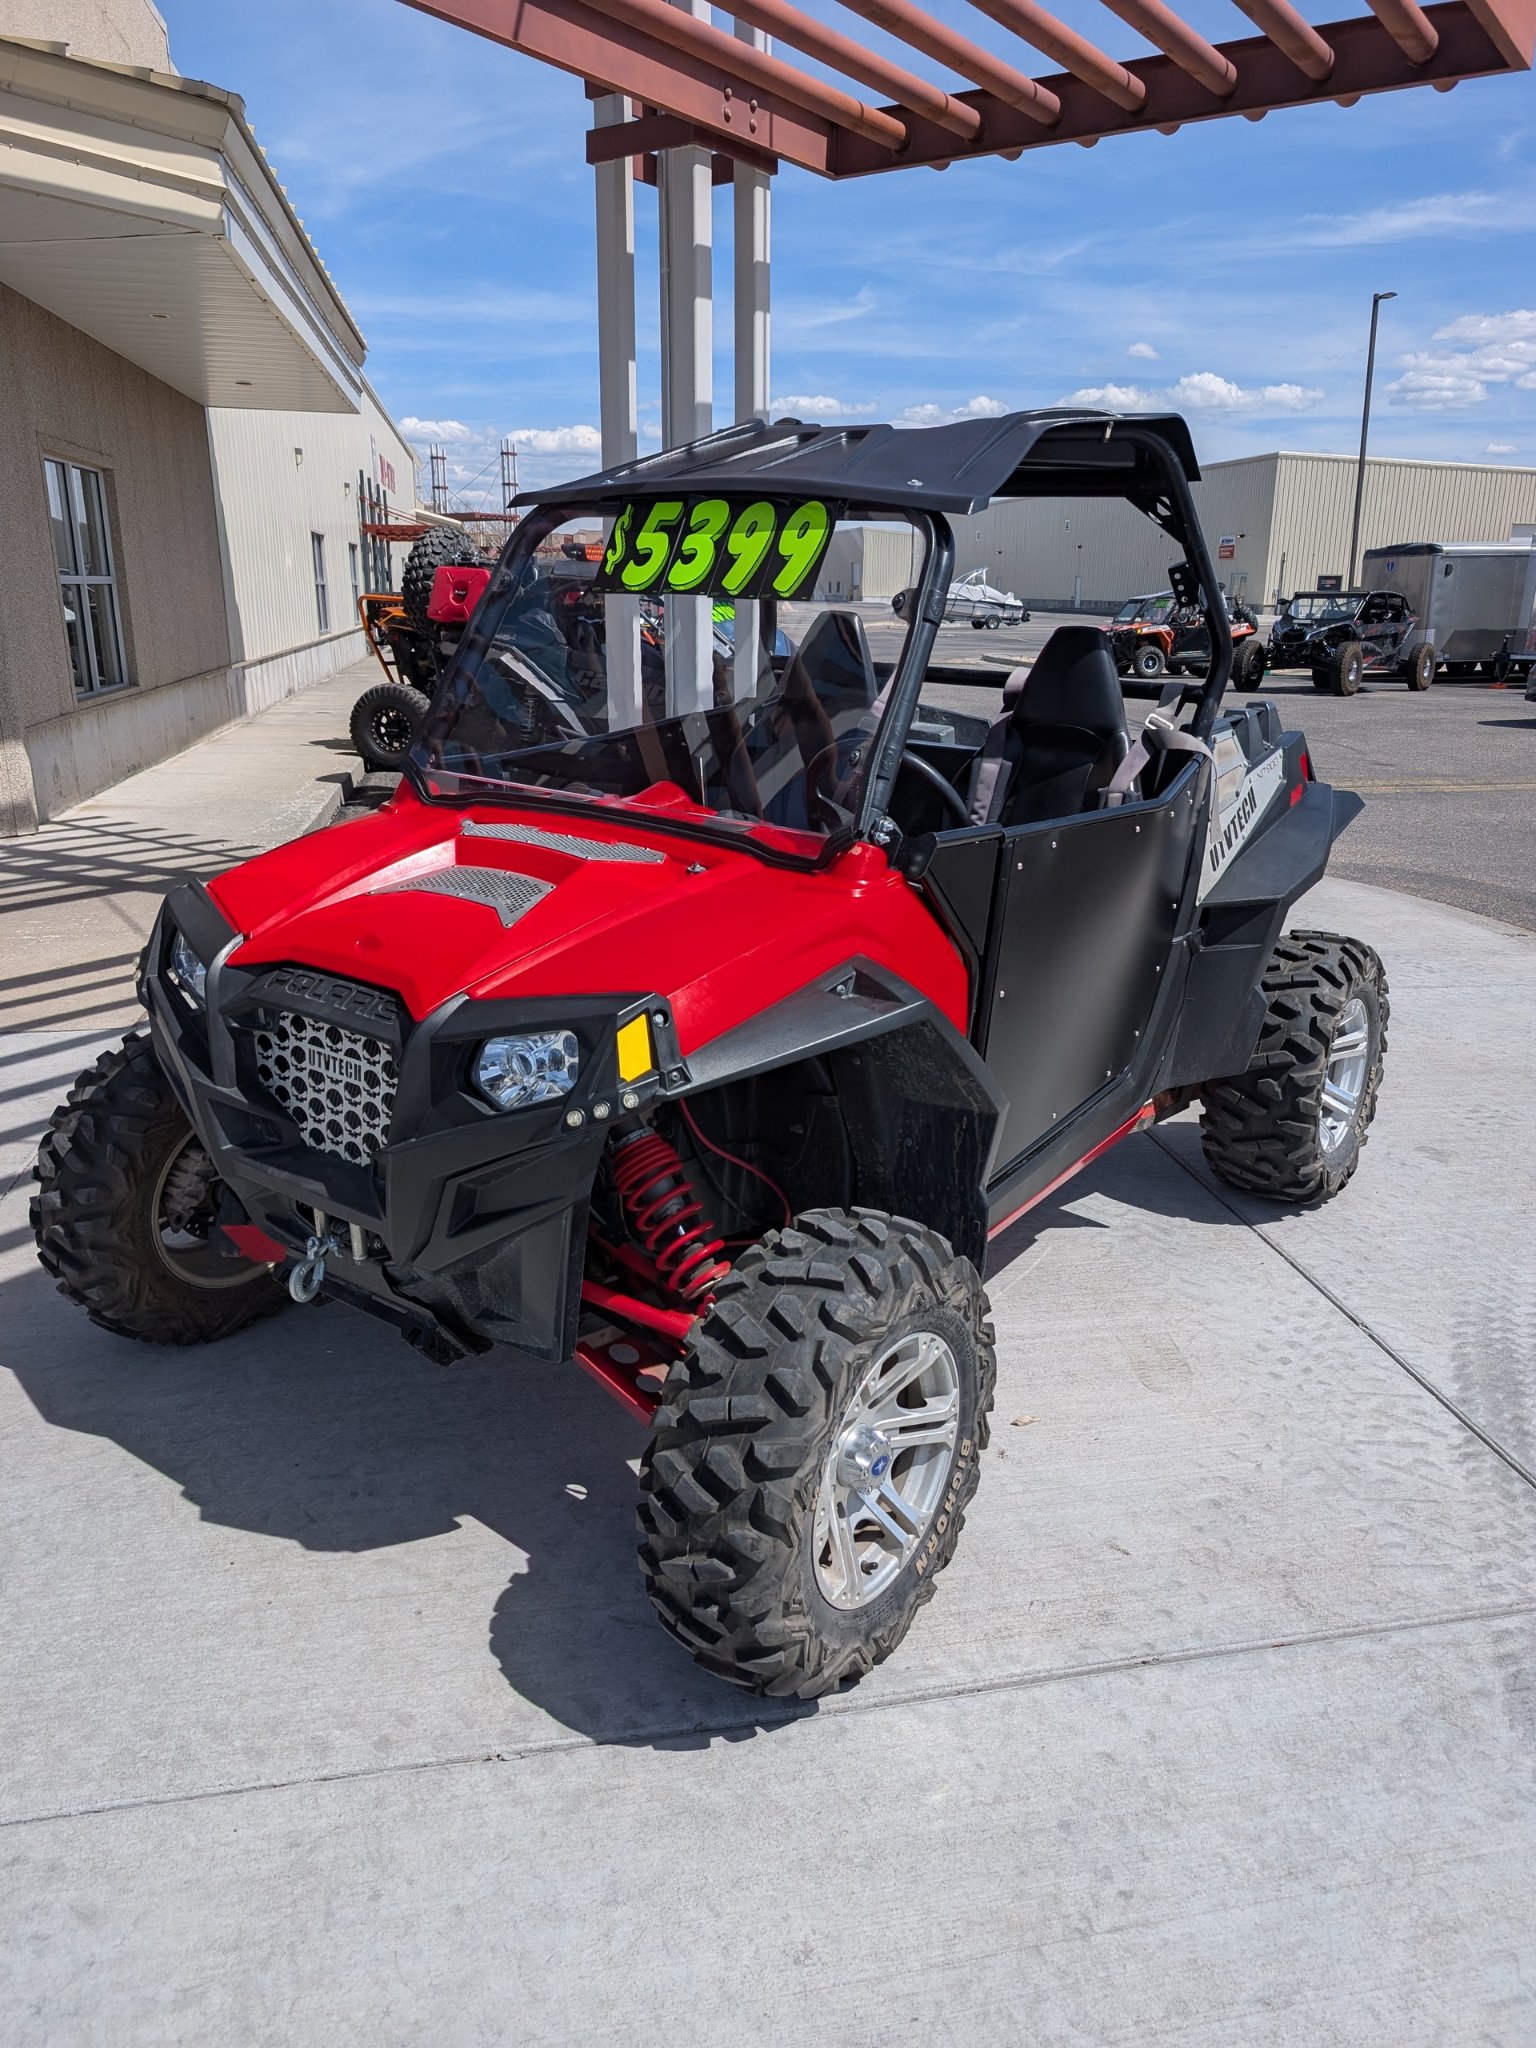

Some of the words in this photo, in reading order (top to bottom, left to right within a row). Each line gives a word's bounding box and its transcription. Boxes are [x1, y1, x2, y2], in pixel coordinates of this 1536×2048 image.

[604, 499, 831, 597] $5399
[1209, 785, 1257, 872] UTVTECH
[264, 967, 400, 1024] POLARIS
[308, 1047, 362, 1082] UTVTECH
[915, 1438, 971, 1576] BIGHORN
